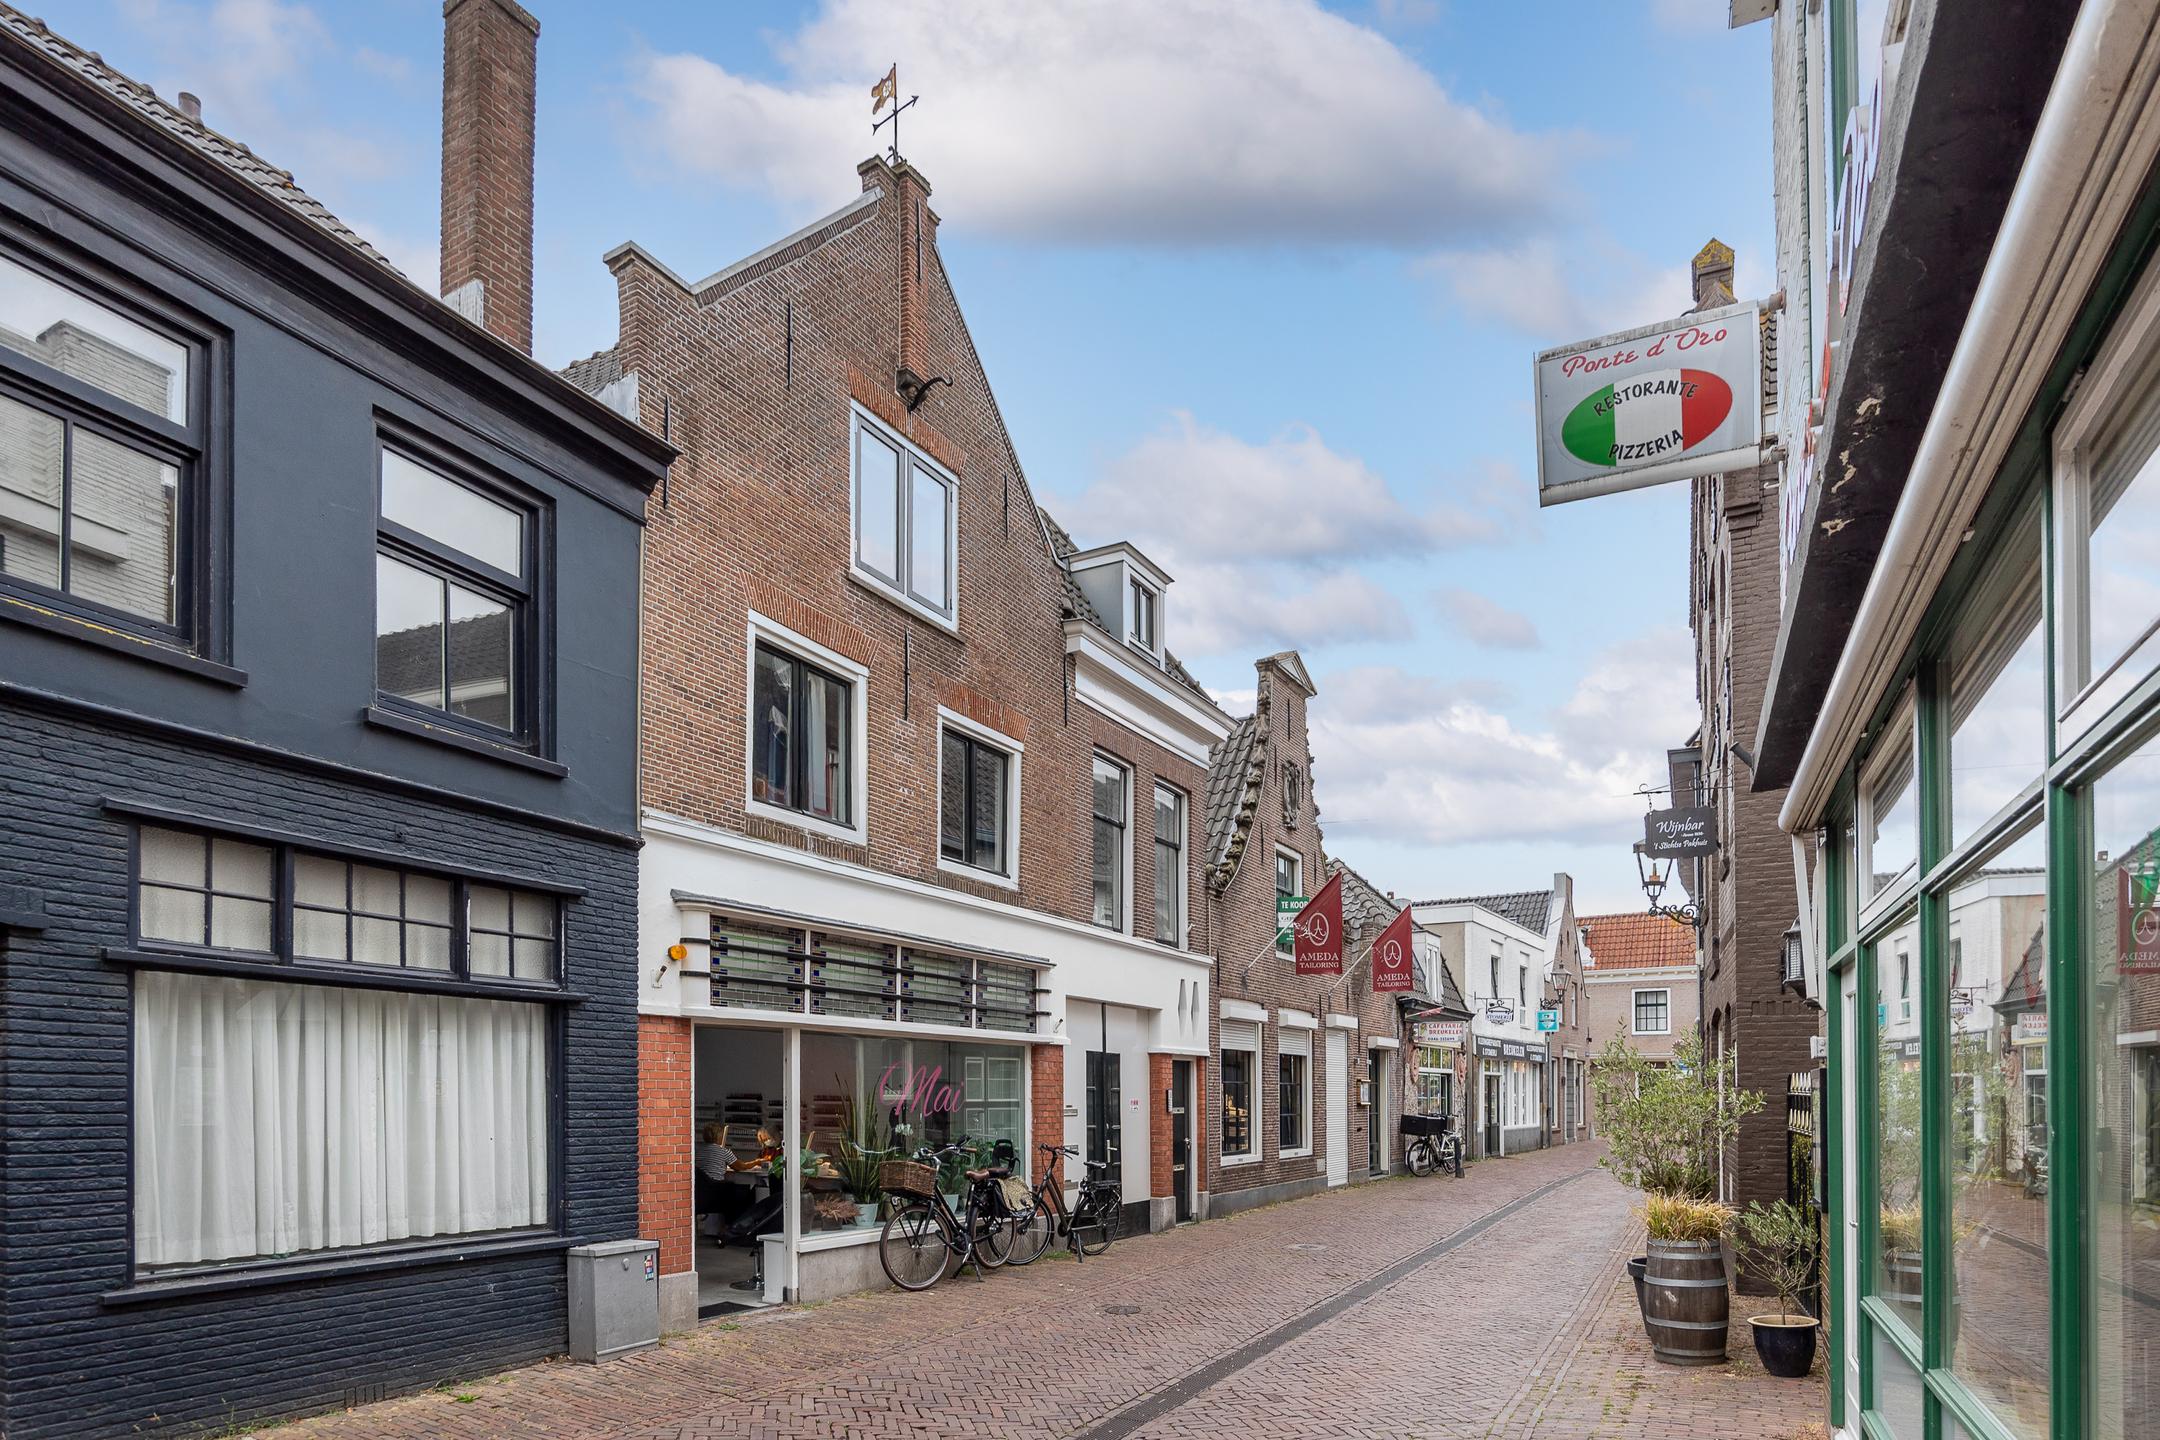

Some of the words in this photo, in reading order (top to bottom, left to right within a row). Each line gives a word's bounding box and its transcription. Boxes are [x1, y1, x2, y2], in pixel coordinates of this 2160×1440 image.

[1562, 350, 1639, 378] Ponte
[1593, 379, 1699, 417] RESTORANTE
[1608, 429, 1684, 461] PIZZERIA
[1655, 816, 1705, 839] Wijnbar
[1281, 901, 1289, 909] TE
[1299, 952, 1339, 962] AMEDA
[1299, 961, 1340, 969] TAILORING
[1376, 972, 1411, 982] AMEDA
[1377, 980, 1411, 988] TAILORING
[879, 1060, 966, 1117] Mai
